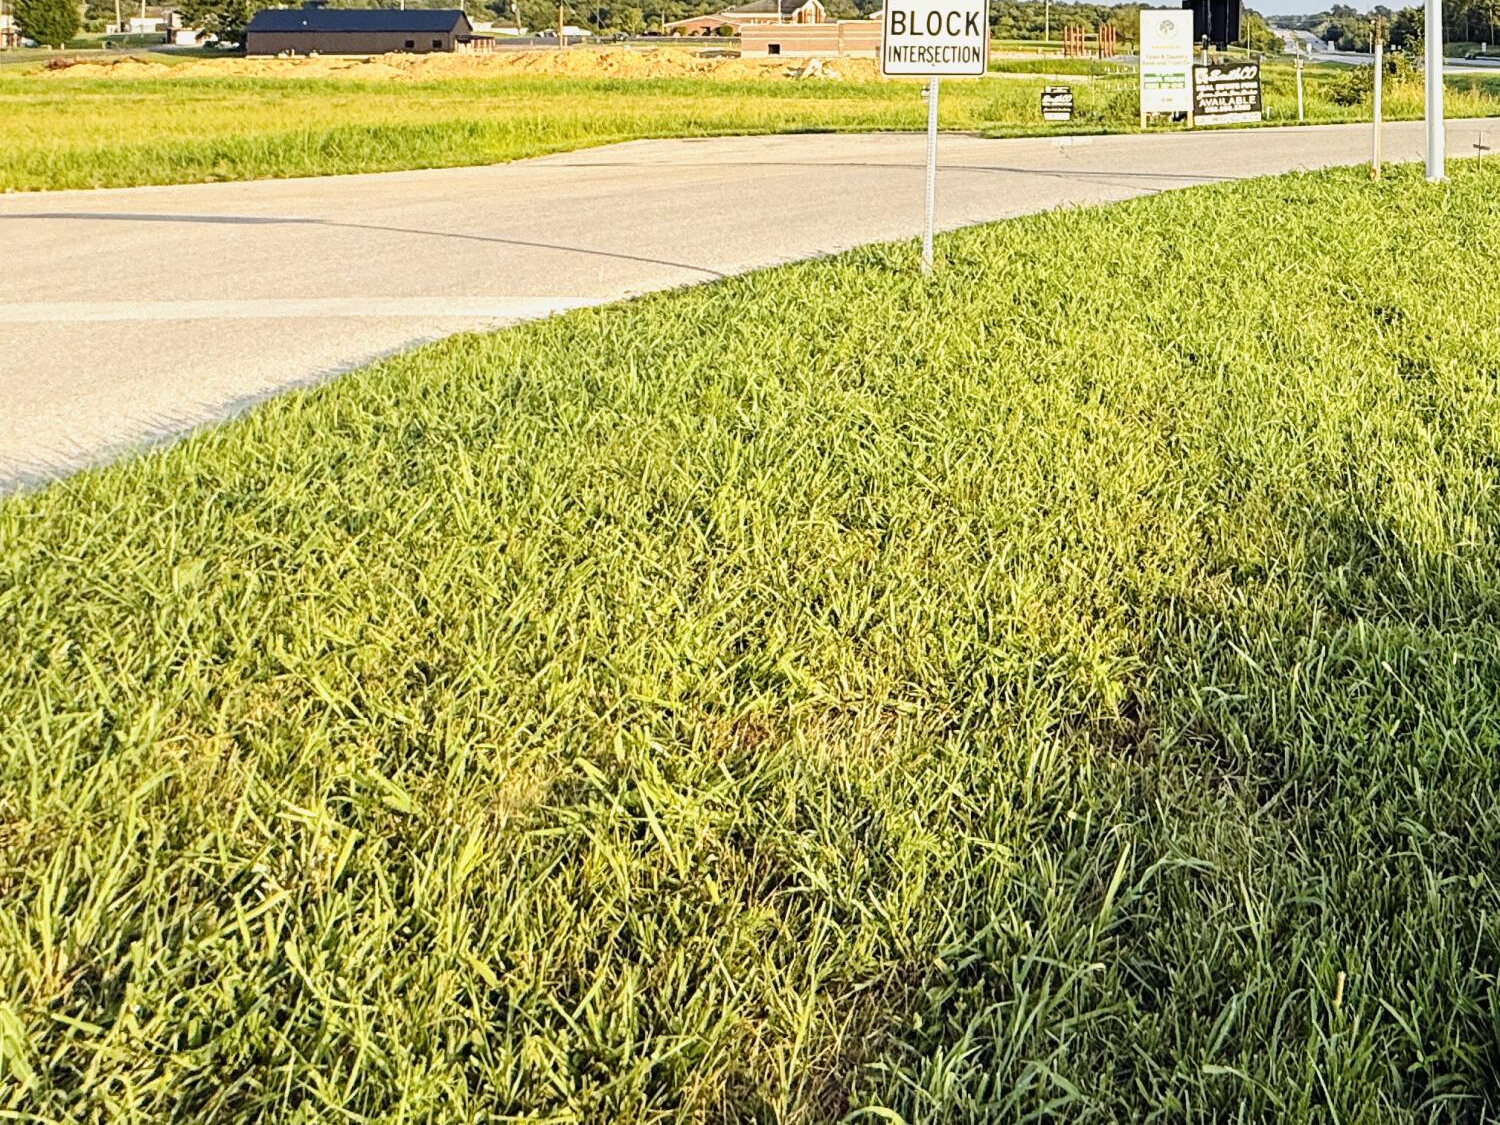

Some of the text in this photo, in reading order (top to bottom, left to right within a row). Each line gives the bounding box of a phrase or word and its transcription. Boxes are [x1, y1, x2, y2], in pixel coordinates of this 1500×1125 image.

[890, 10, 980, 37] BLOCK
[888, 45, 981, 64] INTERSECTION
[1198, 95, 1257, 108] AVAILABLE
